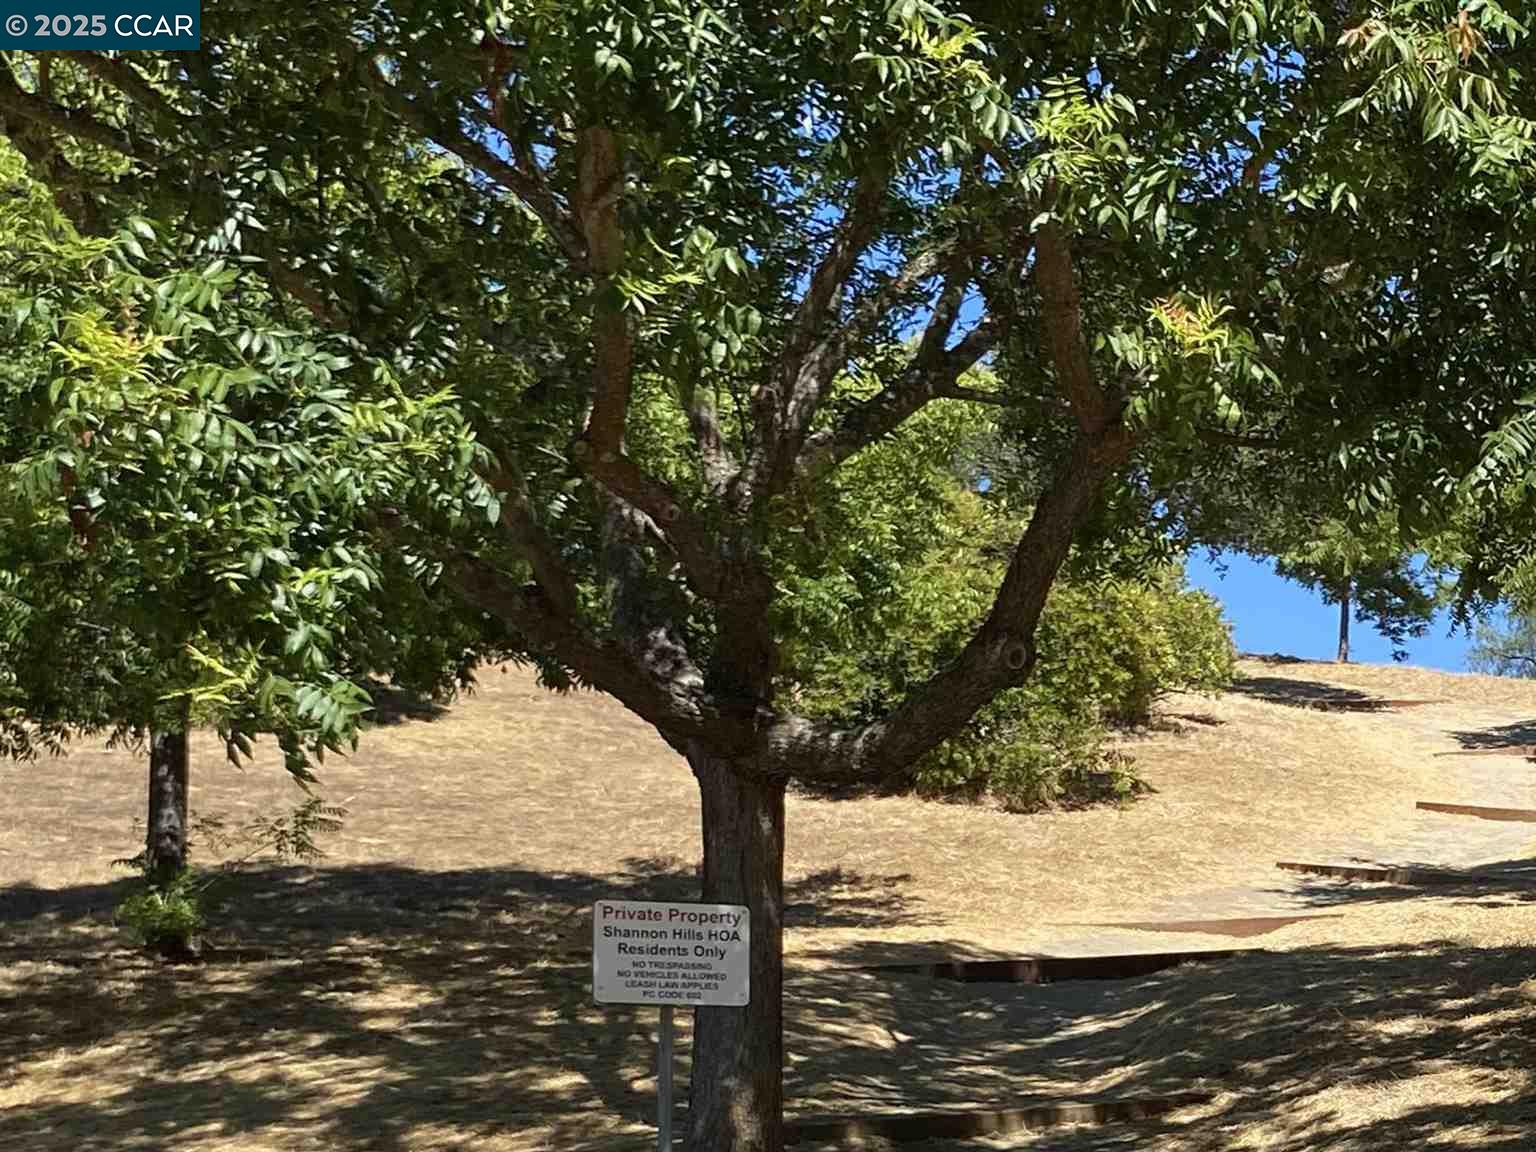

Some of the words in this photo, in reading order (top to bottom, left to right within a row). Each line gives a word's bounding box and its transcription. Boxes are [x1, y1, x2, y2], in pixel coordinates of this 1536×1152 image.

[602, 906, 662, 921] Private
[668, 908, 741, 928] Property
[603, 926, 668, 939] Shannon
[672, 928, 704, 941] Hills
[708, 930, 741, 942] HOA
[618, 942, 689, 956] Residents
[694, 945, 726, 960] Only
[632, 960, 646, 968] NO
[648, 961, 712, 970] TRESPASSING
[633, 970, 679, 979] VEHICLES
[681, 972, 727, 981] ALLOWED
[625, 979, 657, 988] LEASH
[658, 981, 679, 989] LAW
[680, 982, 719, 990] APPLIES
[657, 991, 683, 999] CODE
